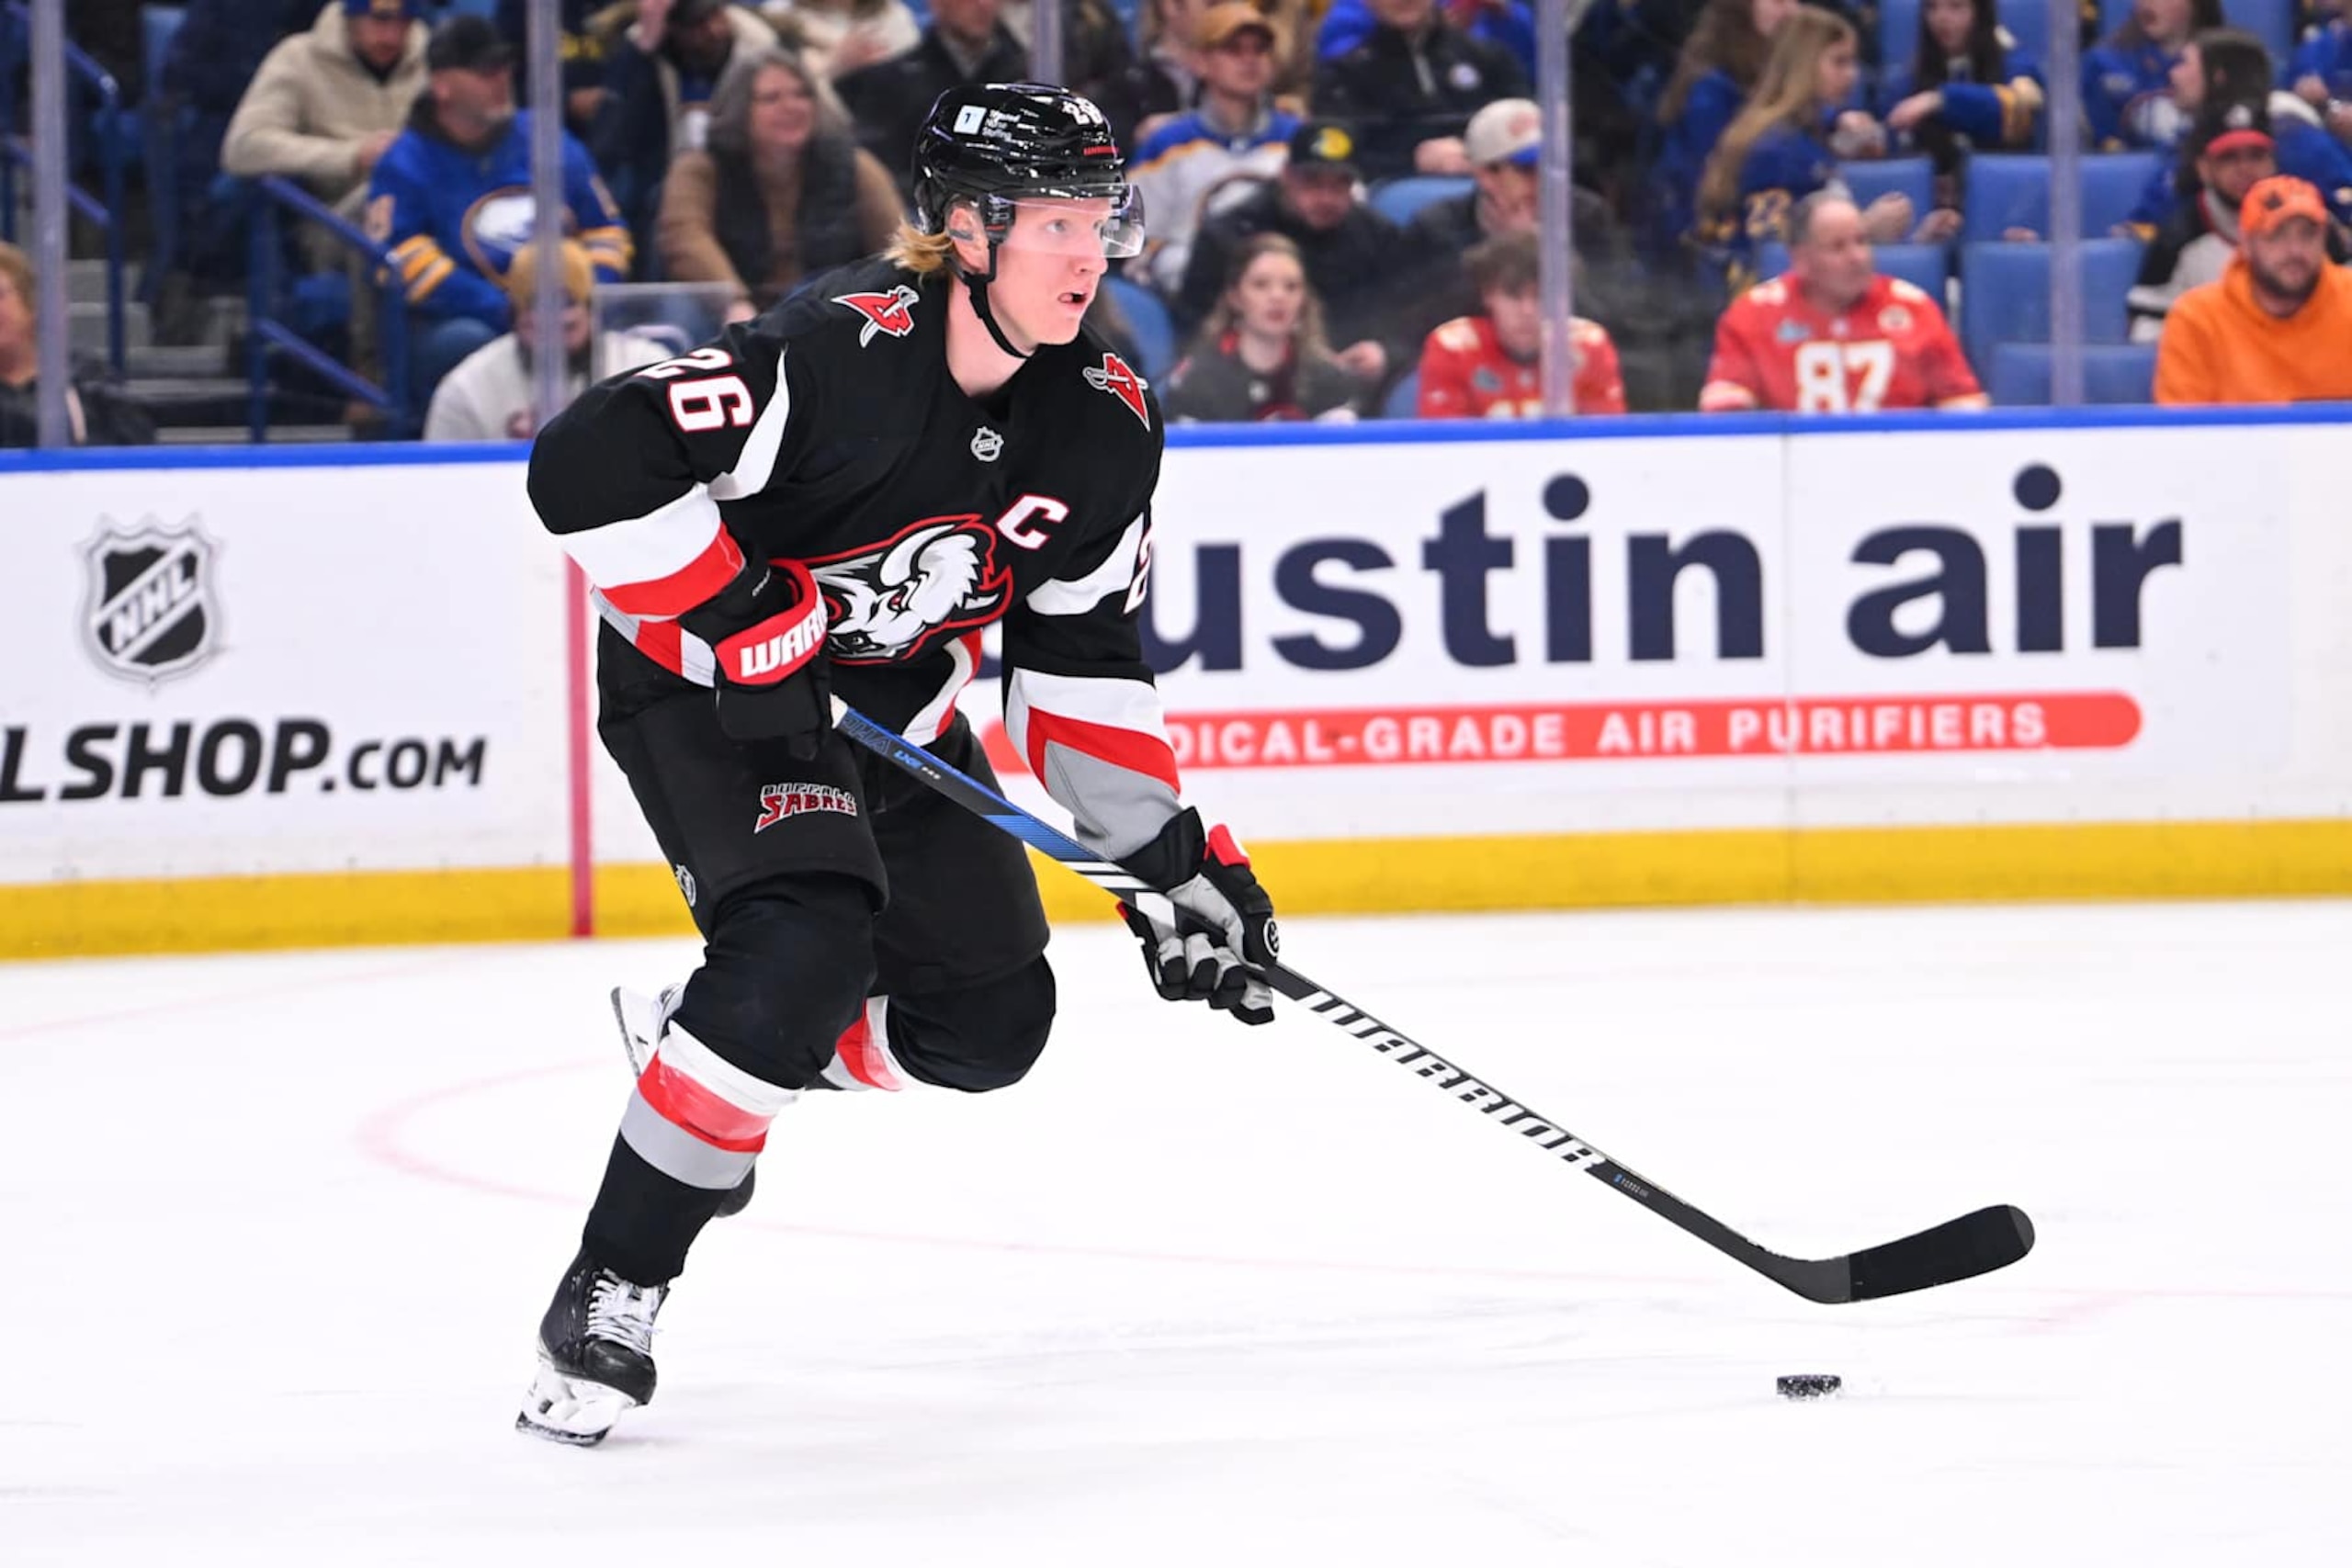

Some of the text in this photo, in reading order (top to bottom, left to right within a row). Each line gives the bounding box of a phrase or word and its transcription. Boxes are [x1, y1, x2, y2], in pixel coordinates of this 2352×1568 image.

[636, 348, 754, 432] 26
[1793, 340, 1895, 415] 87
[996, 493, 1070, 550] C
[109, 561, 194, 650] NHL
[1139, 462, 2183, 678] ustin air
[1598, 711, 1696, 752] AIR
[1728, 702, 2047, 750] PURIFIERS
[754, 792, 858, 834] SABRES
[1295, 990, 1607, 1171] WARRIOR
